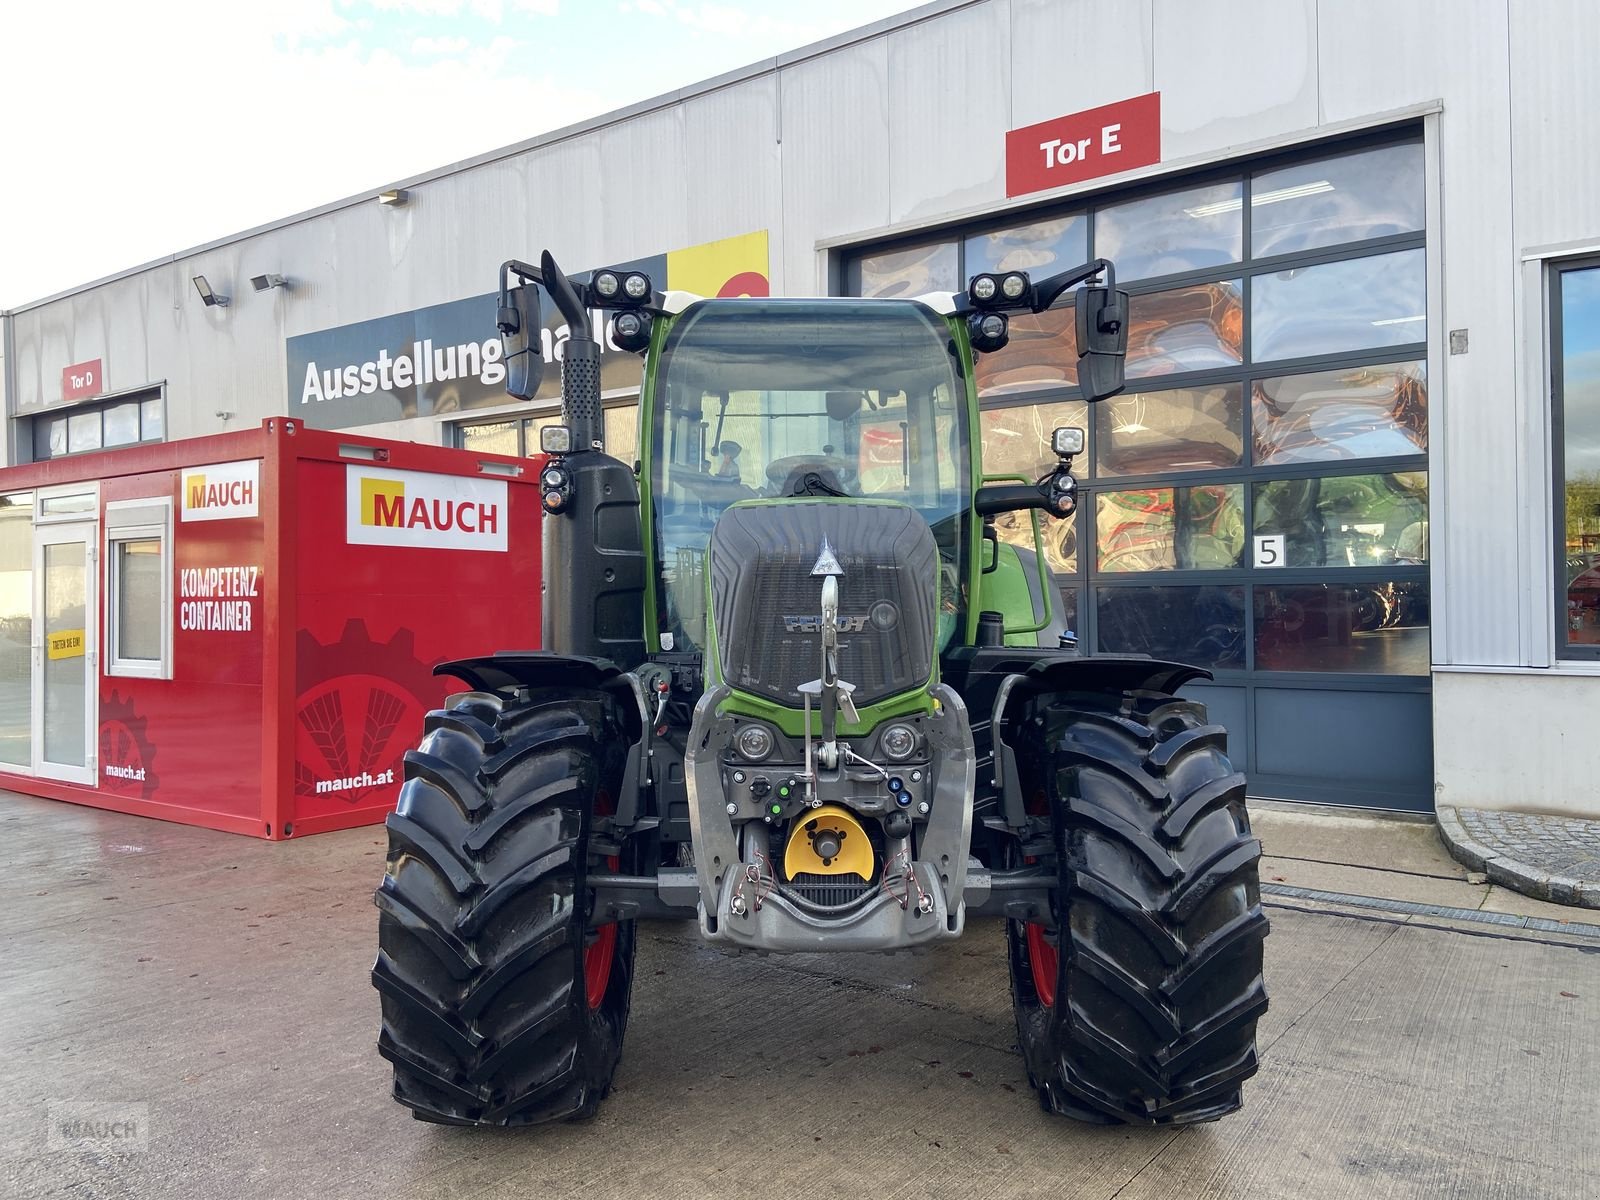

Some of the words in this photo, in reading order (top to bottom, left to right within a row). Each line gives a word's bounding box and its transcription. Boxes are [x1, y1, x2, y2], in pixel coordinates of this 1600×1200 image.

[1040, 139, 1091, 169] Tor
[1101, 123, 1121, 155] E
[71, 375, 84, 389] Tor
[86, 372, 93, 386] D
[192, 480, 253, 509] MAUCH
[374, 494, 498, 534] MAUCH
[1260, 539, 1277, 564] 5
[180, 566, 258, 597] KOMPETENZ
[180, 601, 251, 631] CONTAINER
[106, 764, 146, 781] mauch.at
[316, 769, 394, 793] mauch.at
